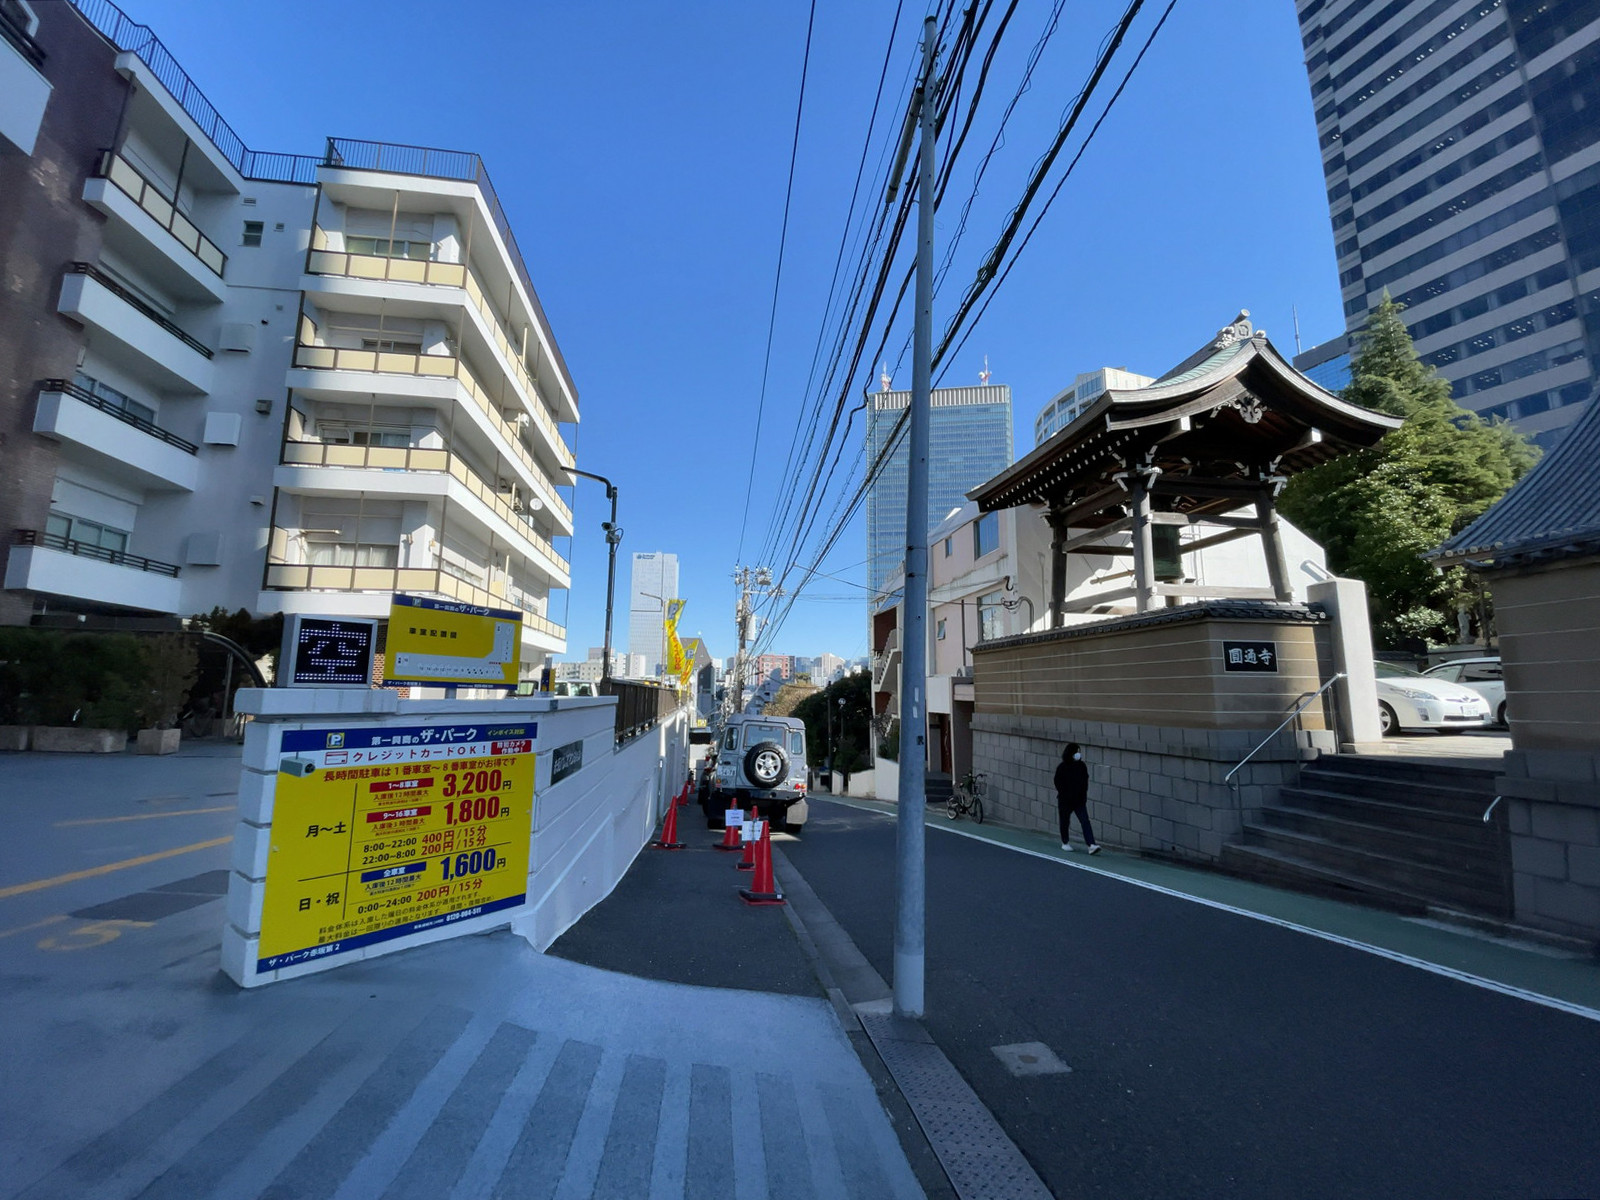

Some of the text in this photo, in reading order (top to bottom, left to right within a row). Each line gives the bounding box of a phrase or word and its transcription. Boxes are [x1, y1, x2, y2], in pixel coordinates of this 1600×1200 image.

[296, 623, 367, 681] 空
[1228, 648, 1273, 665] 圓通寺
